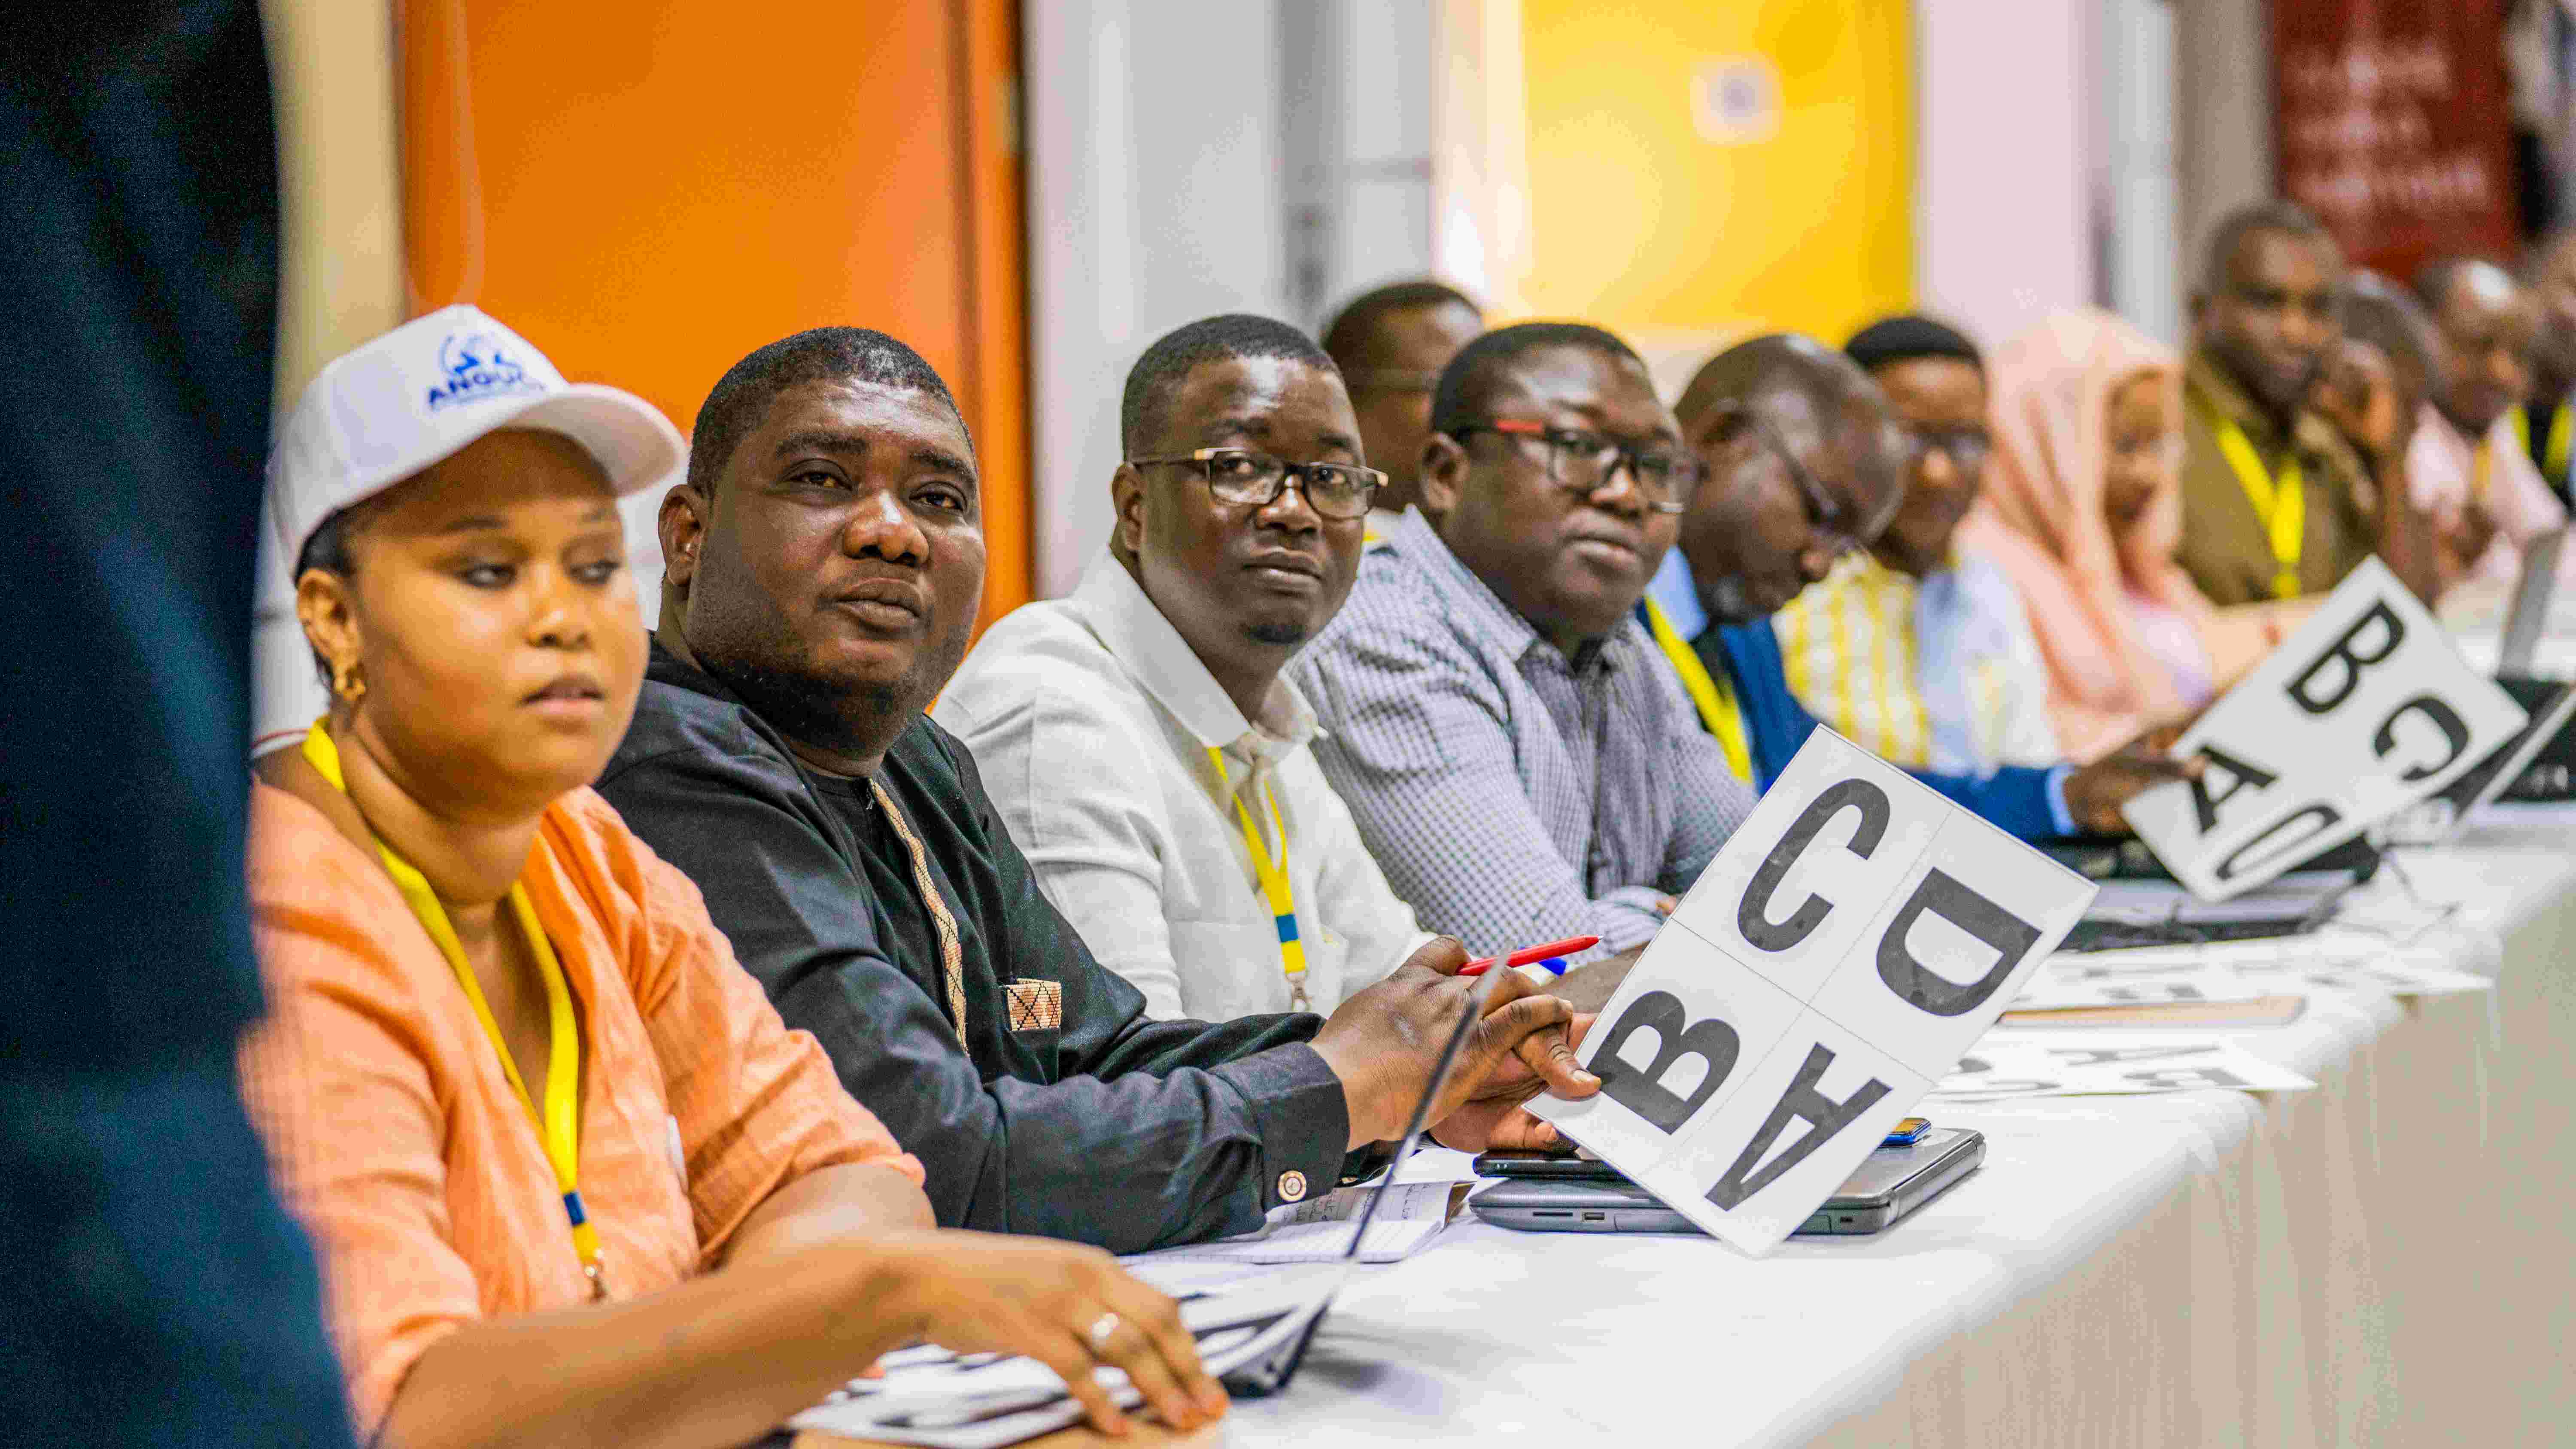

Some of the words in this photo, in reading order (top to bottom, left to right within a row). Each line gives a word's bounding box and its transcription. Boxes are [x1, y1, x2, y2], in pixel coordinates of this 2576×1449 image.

[2286, 600, 2405, 714] B
[2189, 745, 2277, 834] A
[2374, 696, 2469, 781] C
[1738, 779, 1890, 952] C
[1877, 867, 2042, 1016] D
[1586, 991, 1739, 1135] B
[1705, 1042, 1893, 1211] A
